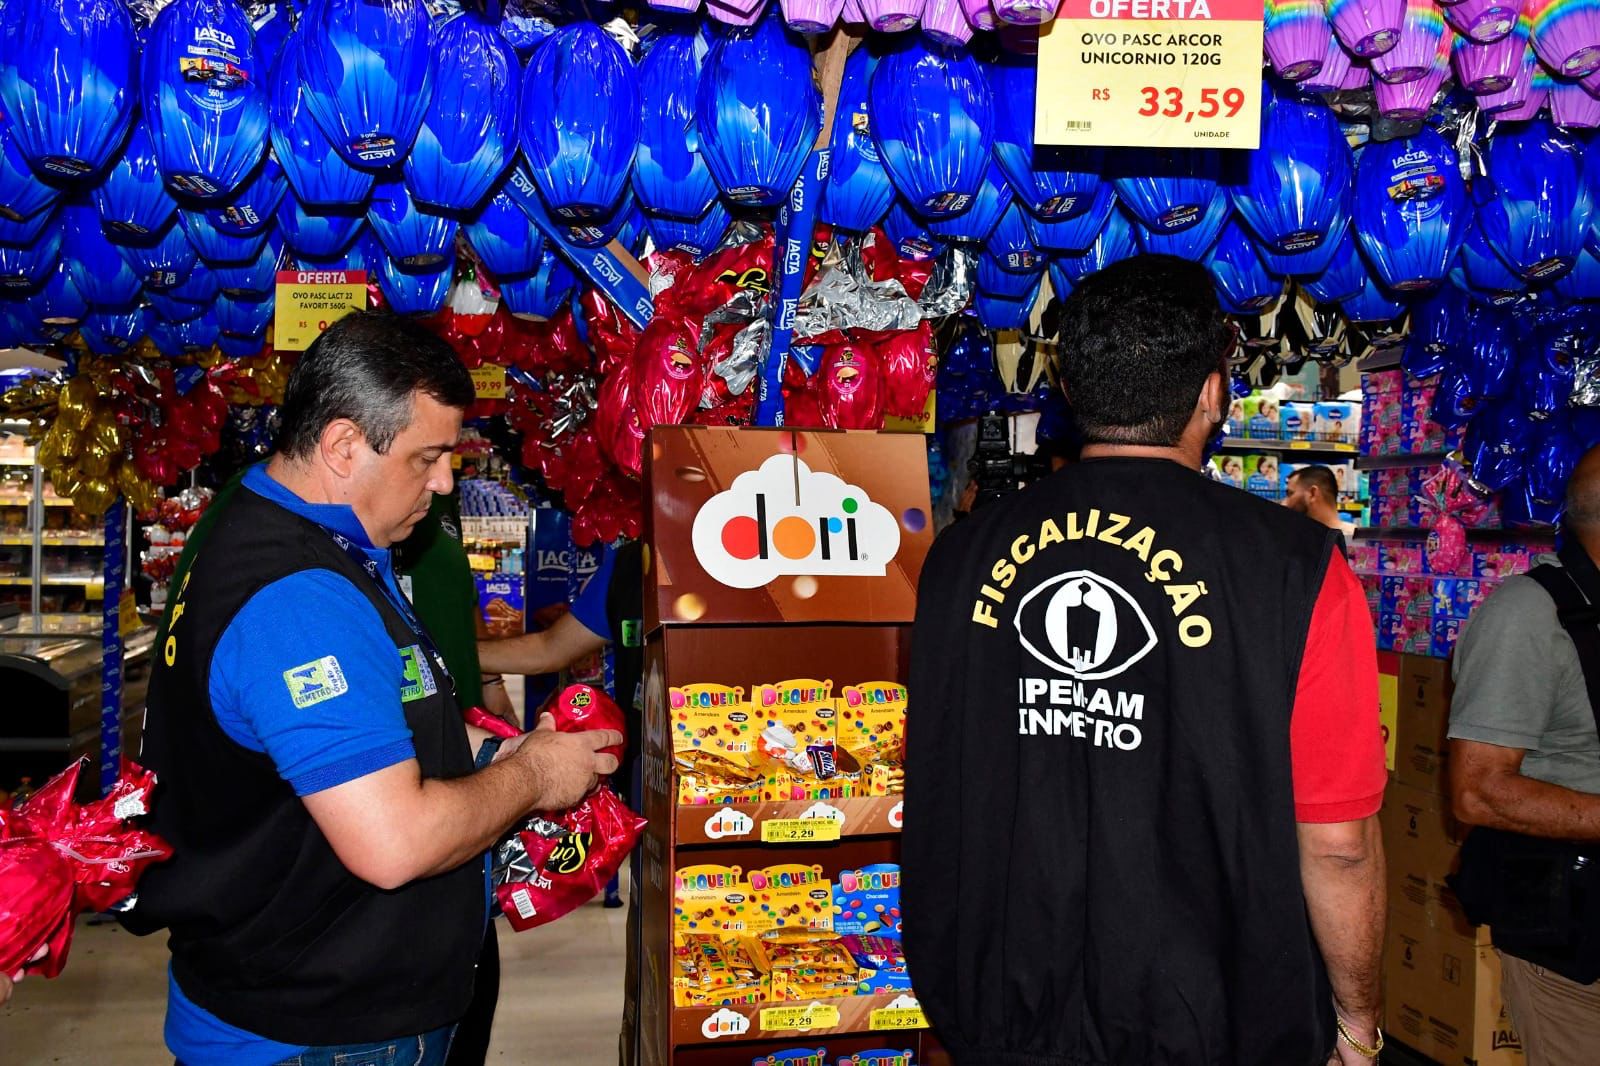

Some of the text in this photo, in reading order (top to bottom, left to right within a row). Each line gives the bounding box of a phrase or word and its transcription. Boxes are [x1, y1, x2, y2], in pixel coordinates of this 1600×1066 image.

[1089, 0, 1212, 19] OFERTA
[194, 26, 236, 50] LACTA
[1081, 33, 1222, 47] OVO PASC ARCOR
[1081, 51, 1222, 66] UNICORNIO 120G
[1091, 86, 1245, 124] R$ 33,59
[357, 148, 396, 161] LACTA
[1392, 150, 1429, 169] LACTA
[816, 150, 831, 181] LACTA
[509, 166, 537, 198] LACT
[240, 203, 260, 225] LACTA
[784, 237, 802, 275] LACTA
[297, 272, 347, 284] OFERTA
[591, 252, 624, 287] LACTA
[292, 292, 353, 300] OVO PASC LACT 22
[300, 302, 346, 310] FAVORIT 560G
[635, 297, 655, 321] CTA
[780, 298, 798, 331] LACTA
[720, 493, 859, 562] dori
[971, 508, 1213, 649] FISCALIZAÇÃO
[486, 582, 512, 595] LACTA
[294, 685, 333, 706] INMETRO
[400, 686, 421, 697] ETRO
[726, 740, 747, 752] dori
[711, 815, 744, 833] dori
[1409, 815, 1417, 830] 6
[790, 829, 814, 840] 2,29
[722, 920, 742, 930] dori
[1404, 944, 1413, 961] 6
[708, 1016, 740, 1033] dori
[788, 1017, 812, 1027] 2,29
[896, 1017, 918, 1027] 2,29
